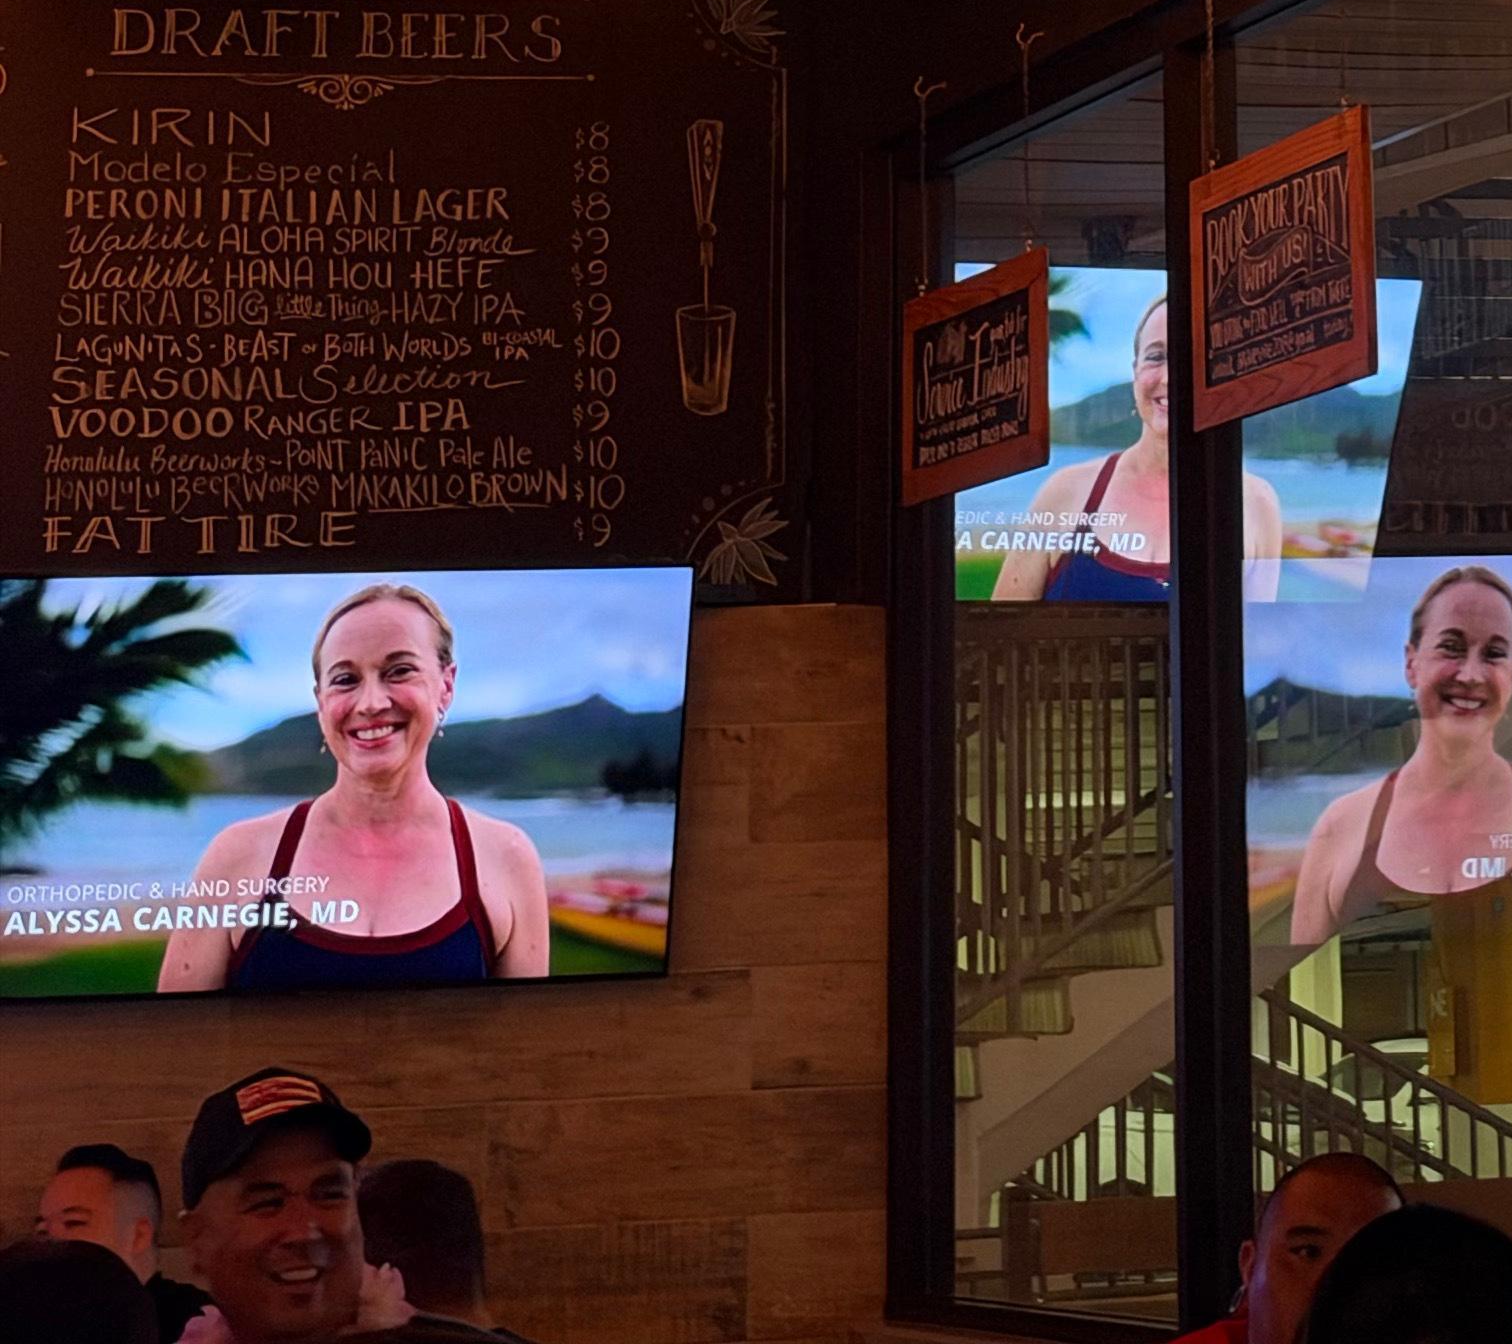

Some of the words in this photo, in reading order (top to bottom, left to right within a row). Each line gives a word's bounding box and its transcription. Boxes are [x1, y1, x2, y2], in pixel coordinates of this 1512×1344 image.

[108, 8, 339, 57] DRAFT
[355, 12, 562, 63] BEERS
[72, 106, 271, 147] KIRIN
[575, 120, 610, 151] $8
[68, 150, 207, 183] Modelo
[221, 146, 395, 192] Especial
[573, 155, 610, 184] $8
[64, 187, 202, 220] PERONI
[221, 187, 377, 226] ITALIAN
[391, 187, 510, 225] LAGER
[571, 191, 611, 221] $8
[65, 222, 212, 255] Waikiki
[218, 223, 325, 255] ALOHA
[332, 226, 423, 256] SPIRIT
[423, 225, 539, 256] Blonde
[570, 226, 610, 255] $9
[1206, 199, 1252, 311] BOOK
[1250, 184, 1292, 240] YOUR
[1292, 165, 1349, 263] PARTY
[58, 252, 215, 291] Waikiki
[225, 256, 315, 289] HANA
[328, 260, 392, 291] HOU
[409, 256, 505, 290] HEFE
[571, 260, 608, 286] $9
[1242, 255, 1278, 292] WITH
[57, 289, 182, 327] SIERRA
[193, 288, 269, 329] BIG
[391, 290, 464, 324] HAZY
[473, 291, 526, 325] IPA
[571, 292, 612, 325] $9
[224, 328, 297, 368] BEAST
[323, 333, 375, 362] BOTH
[382, 330, 473, 362] WORLDS
[573, 327, 622, 361] $10
[494, 345, 531, 361] IPA
[51, 366, 299, 405] SEASONAL
[298, 364, 529, 405] Selection
[573, 365, 617, 398] $10
[48, 406, 235, 441] VOODOO
[243, 404, 384, 440] RANGER
[391, 397, 472, 433] IPA
[571, 400, 611, 433] $9
[43, 443, 141, 474] Honolulu
[149, 443, 267, 475] Beerworks
[438, 435, 485, 469] Pale
[491, 434, 534, 469] Ale
[573, 435, 618, 471] $10
[330, 471, 466, 512] MAKAKILO
[469, 463, 568, 512] BROWN
[574, 474, 626, 510] $10
[42, 515, 167, 554] FAT
[180, 512, 356, 554] TIRE
[573, 513, 611, 548] $9
[1011, 511, 1055, 526] HAND
[1058, 512, 1128, 527] SURGERY
[980, 531, 1102, 555] CARNEGIE,
[1110, 533, 1147, 552] MD
[7, 882, 143, 904] ORTHOPEDIC
[150, 882, 165, 900] &
[172, 878, 231, 900] HAND
[236, 875, 331, 898] SURGERY
[3, 908, 123, 936] ALYSSA
[132, 901, 299, 932] CARNEGIE,
[310, 900, 361, 925] MD
